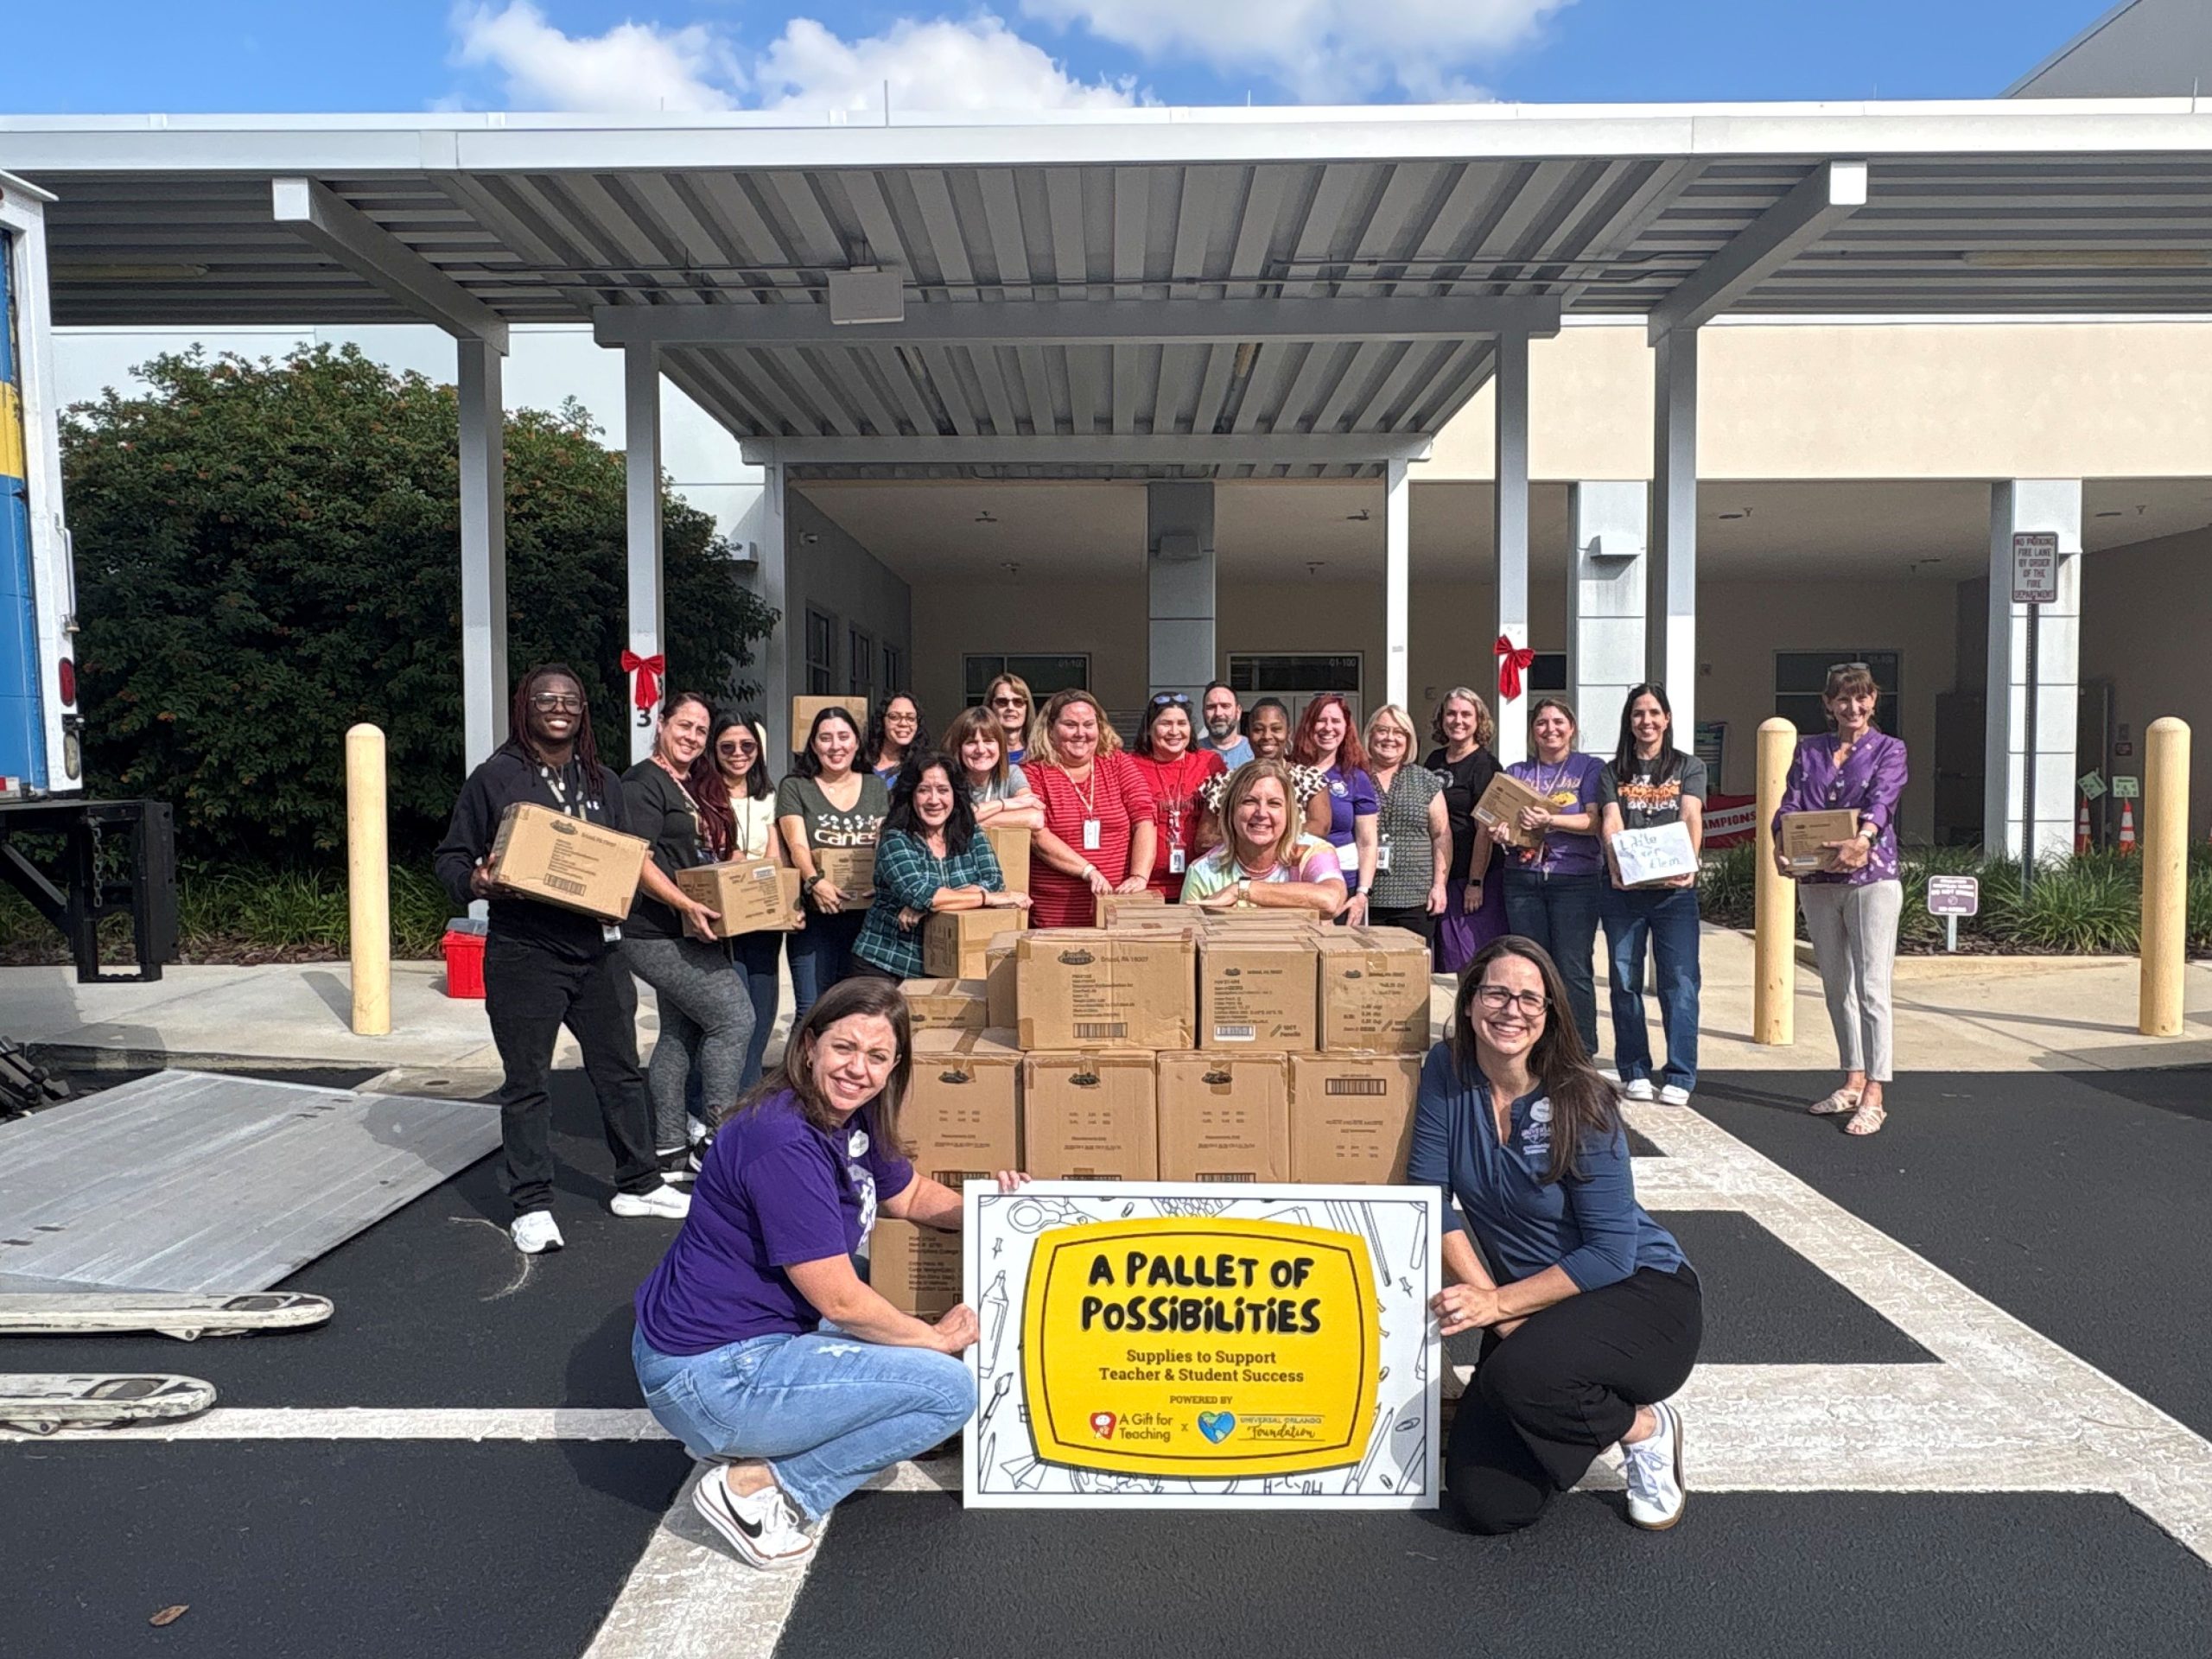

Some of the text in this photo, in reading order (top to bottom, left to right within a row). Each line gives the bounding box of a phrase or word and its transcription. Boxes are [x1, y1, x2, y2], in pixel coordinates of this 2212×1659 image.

[2018, 547, 2051, 556] FIRE LANE
[2018, 558, 2050, 568] BY ORDER
[2023, 569, 2046, 578] OF THE
[2027, 579, 2041, 588] FIRE
[636, 706, 652, 728] 3
[1703, 810, 1757, 830] AMPIONS
[1089, 1250, 1315, 1288] A PALLET OF
[1127, 1349, 1276, 1366] Supplies to Support
[1099, 1367, 1304, 1382] Teacher & Student Success
[1169, 1395, 1233, 1405] POWERED BY
[1119, 1413, 1173, 1426] A Gift for
[1119, 1427, 1171, 1443] Teaching
[1247, 1422, 1316, 1440] Foundation
